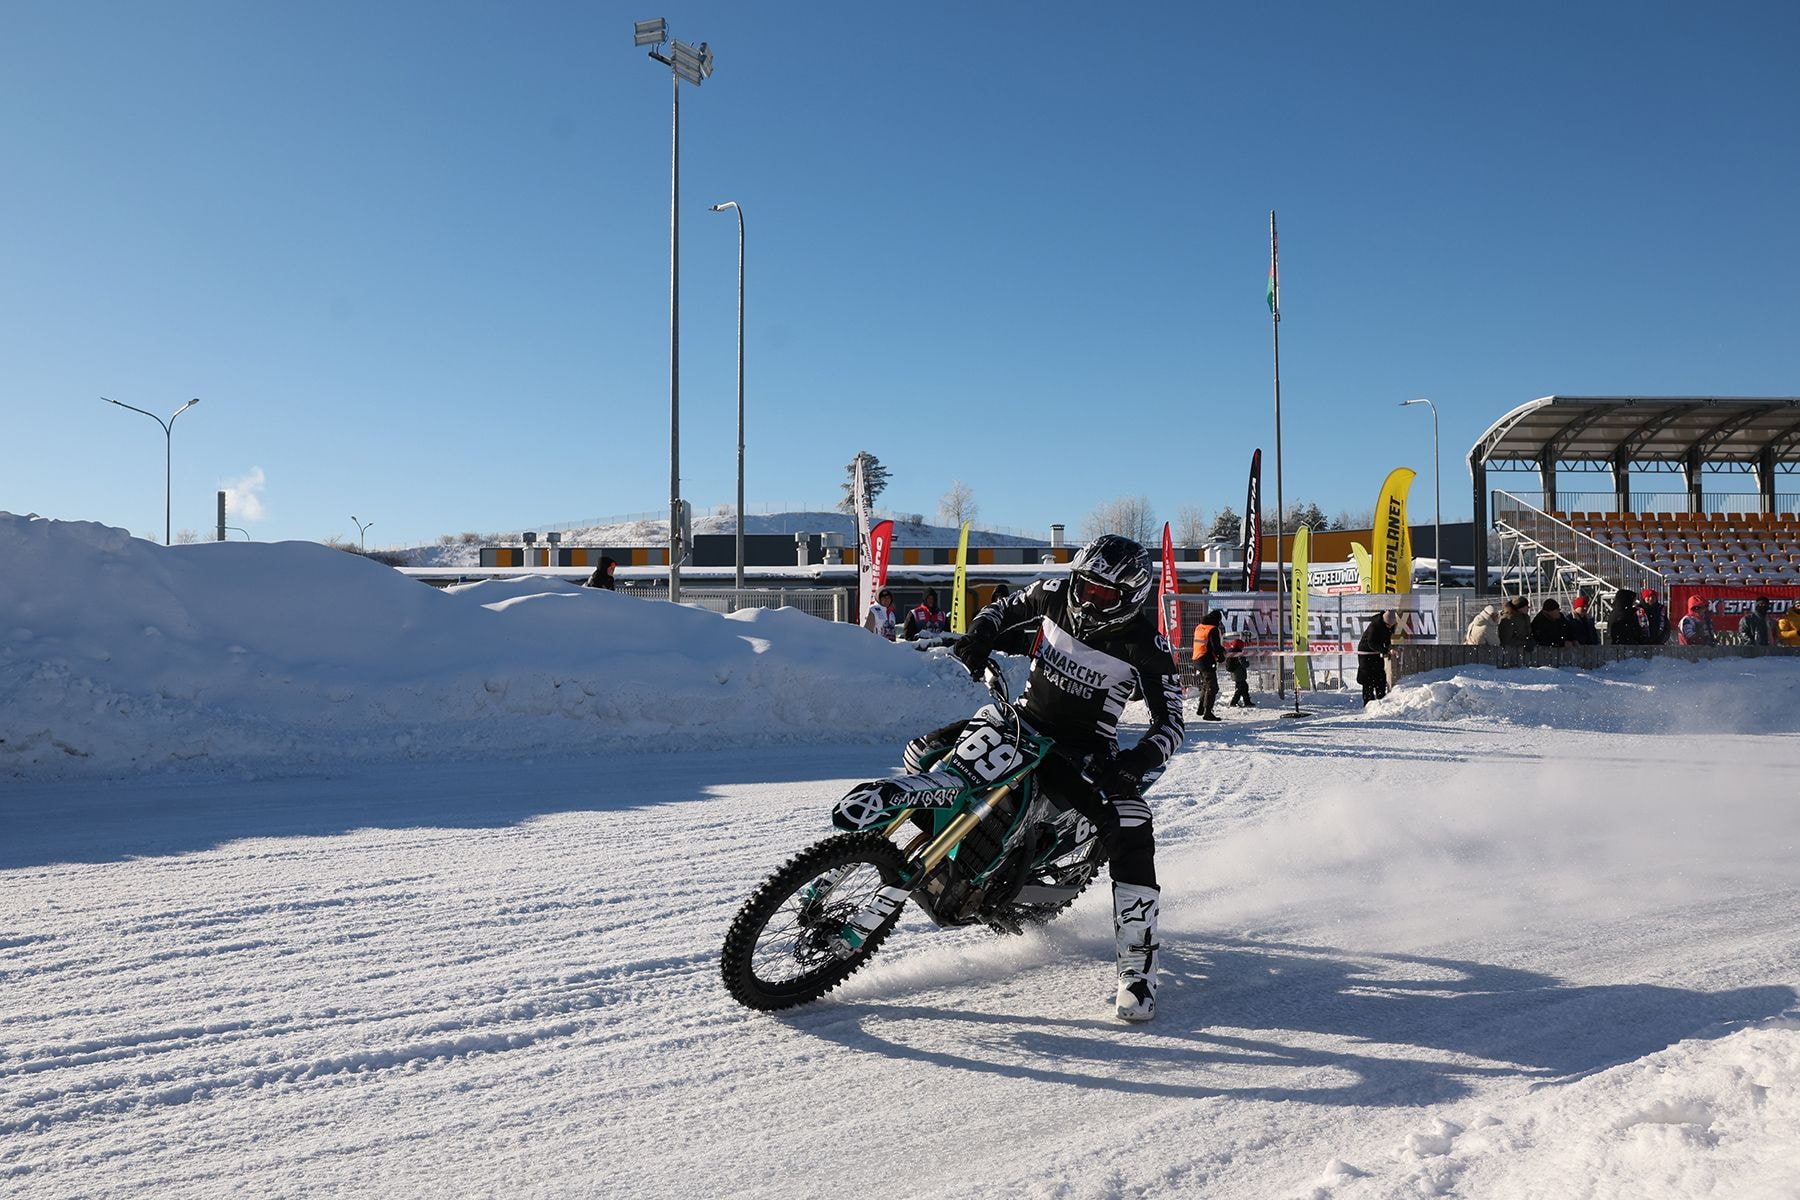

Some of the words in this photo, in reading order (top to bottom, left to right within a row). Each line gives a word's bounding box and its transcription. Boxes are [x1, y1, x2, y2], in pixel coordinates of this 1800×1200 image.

[1384, 495, 1401, 594] OTOPLANET
[1314, 567, 1360, 587] SPEEDWAY
[1043, 645, 1107, 687] ANARCHY
[1043, 665, 1094, 700] RACING
[956, 726, 1023, 781] 69
[1075, 816, 1098, 844] 6
